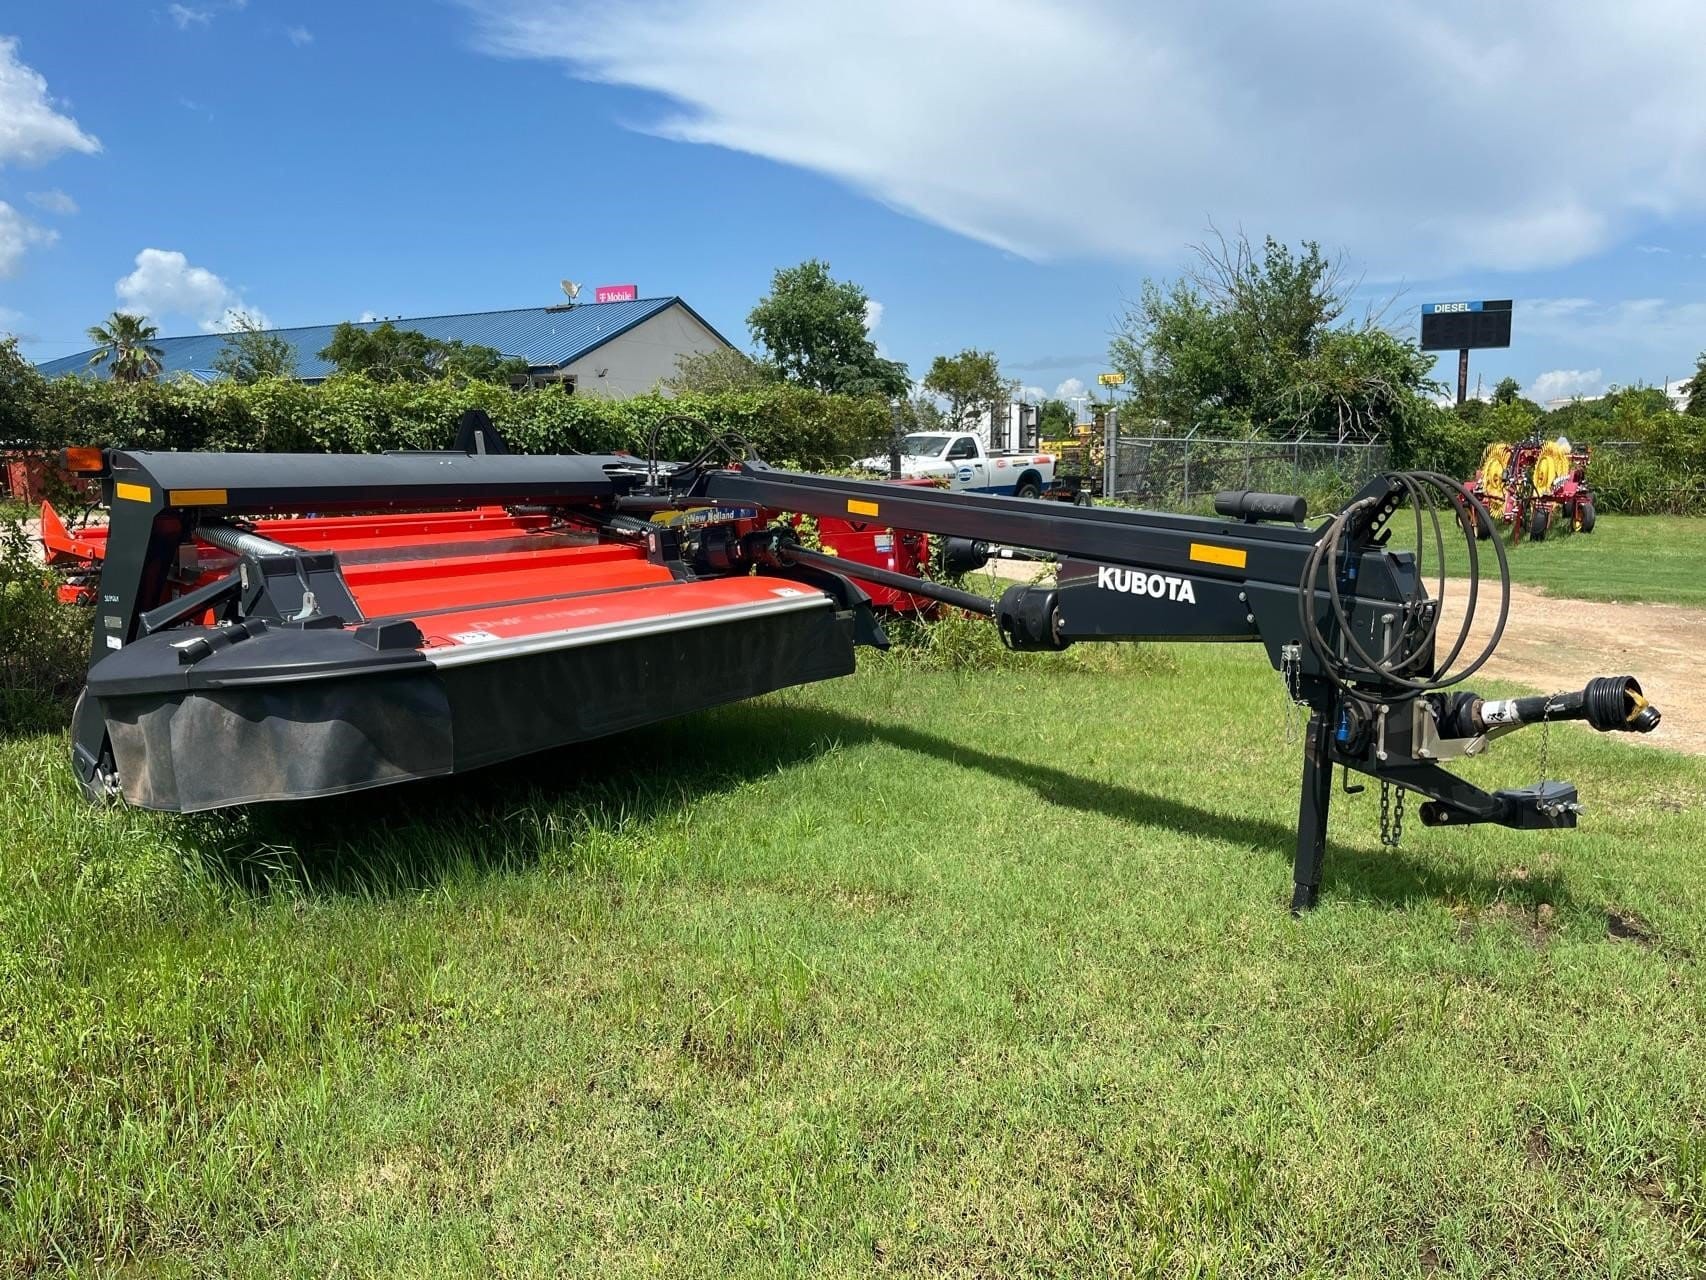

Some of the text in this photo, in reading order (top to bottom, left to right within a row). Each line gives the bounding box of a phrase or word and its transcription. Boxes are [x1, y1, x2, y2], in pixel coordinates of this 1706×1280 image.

[1434, 303, 1471, 313] DIESEL
[688, 513, 706, 523] New
[708, 509, 735, 522] Holland
[1098, 566, 1196, 604] KUBOTA
